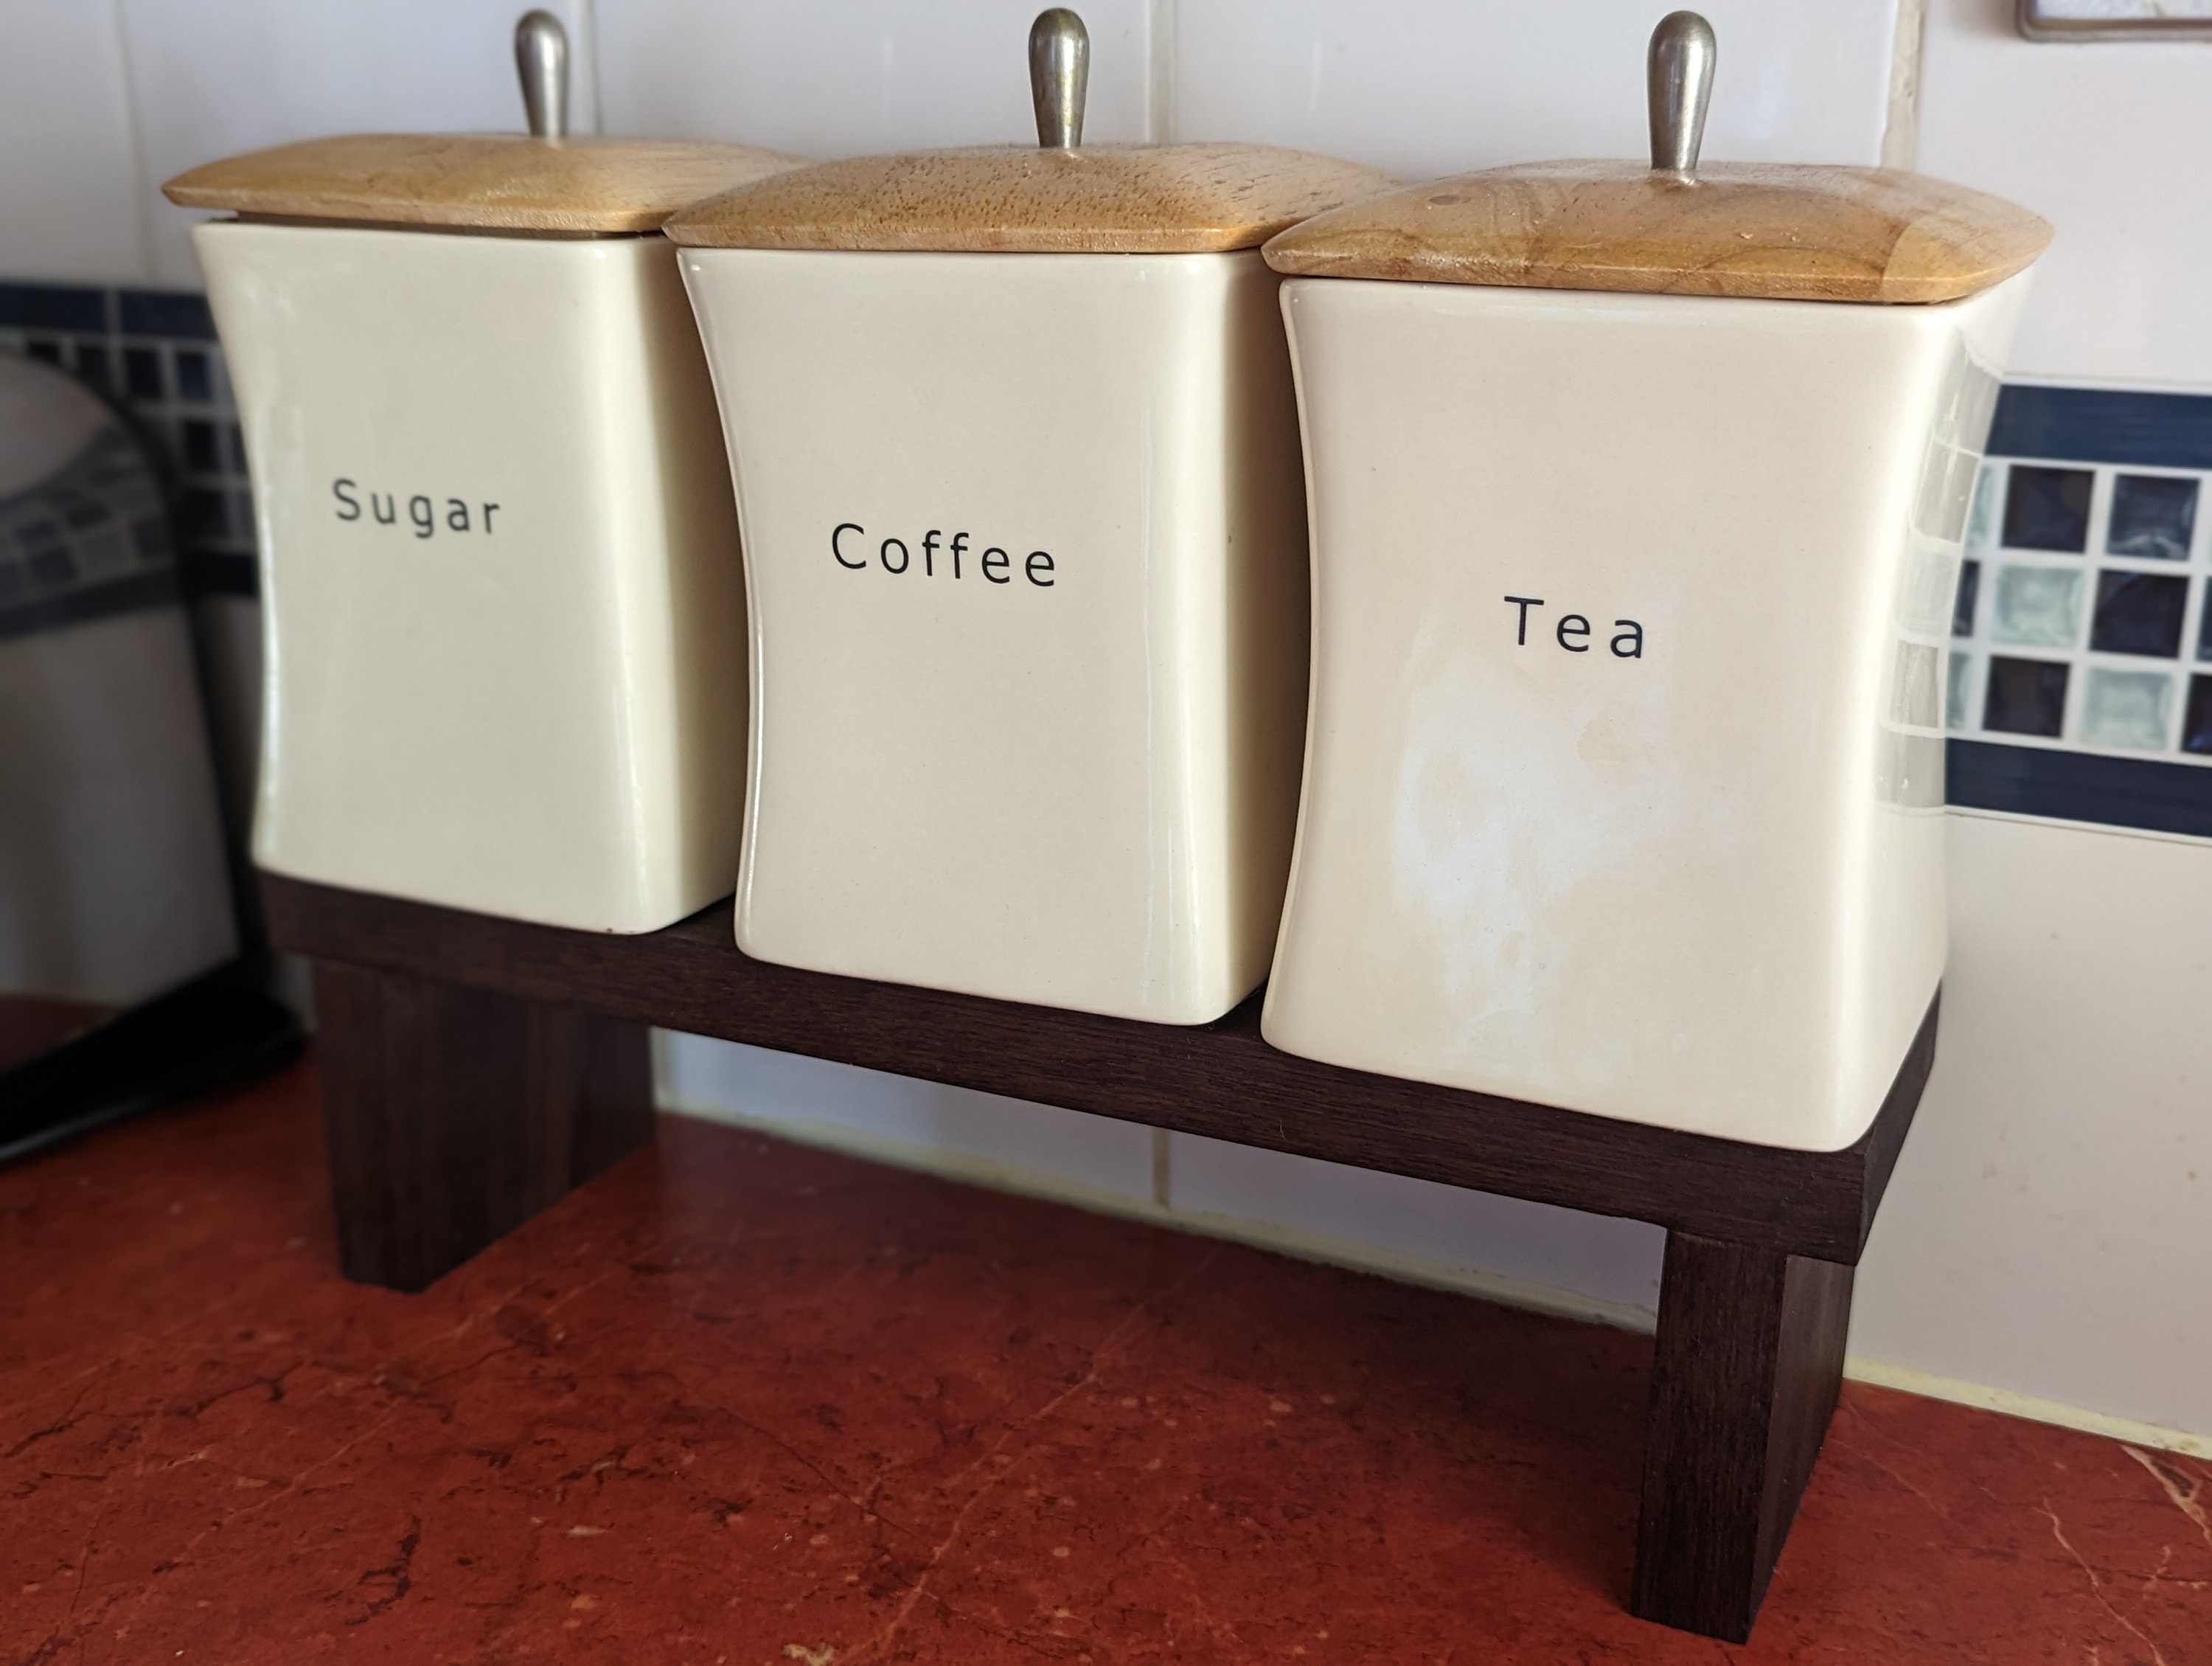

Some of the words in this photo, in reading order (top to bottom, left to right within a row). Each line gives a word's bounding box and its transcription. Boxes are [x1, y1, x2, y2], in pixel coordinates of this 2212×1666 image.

[333, 478, 500, 539] Sugar
[832, 523, 1055, 587] Coffee
[1503, 595, 1644, 659] Tea
